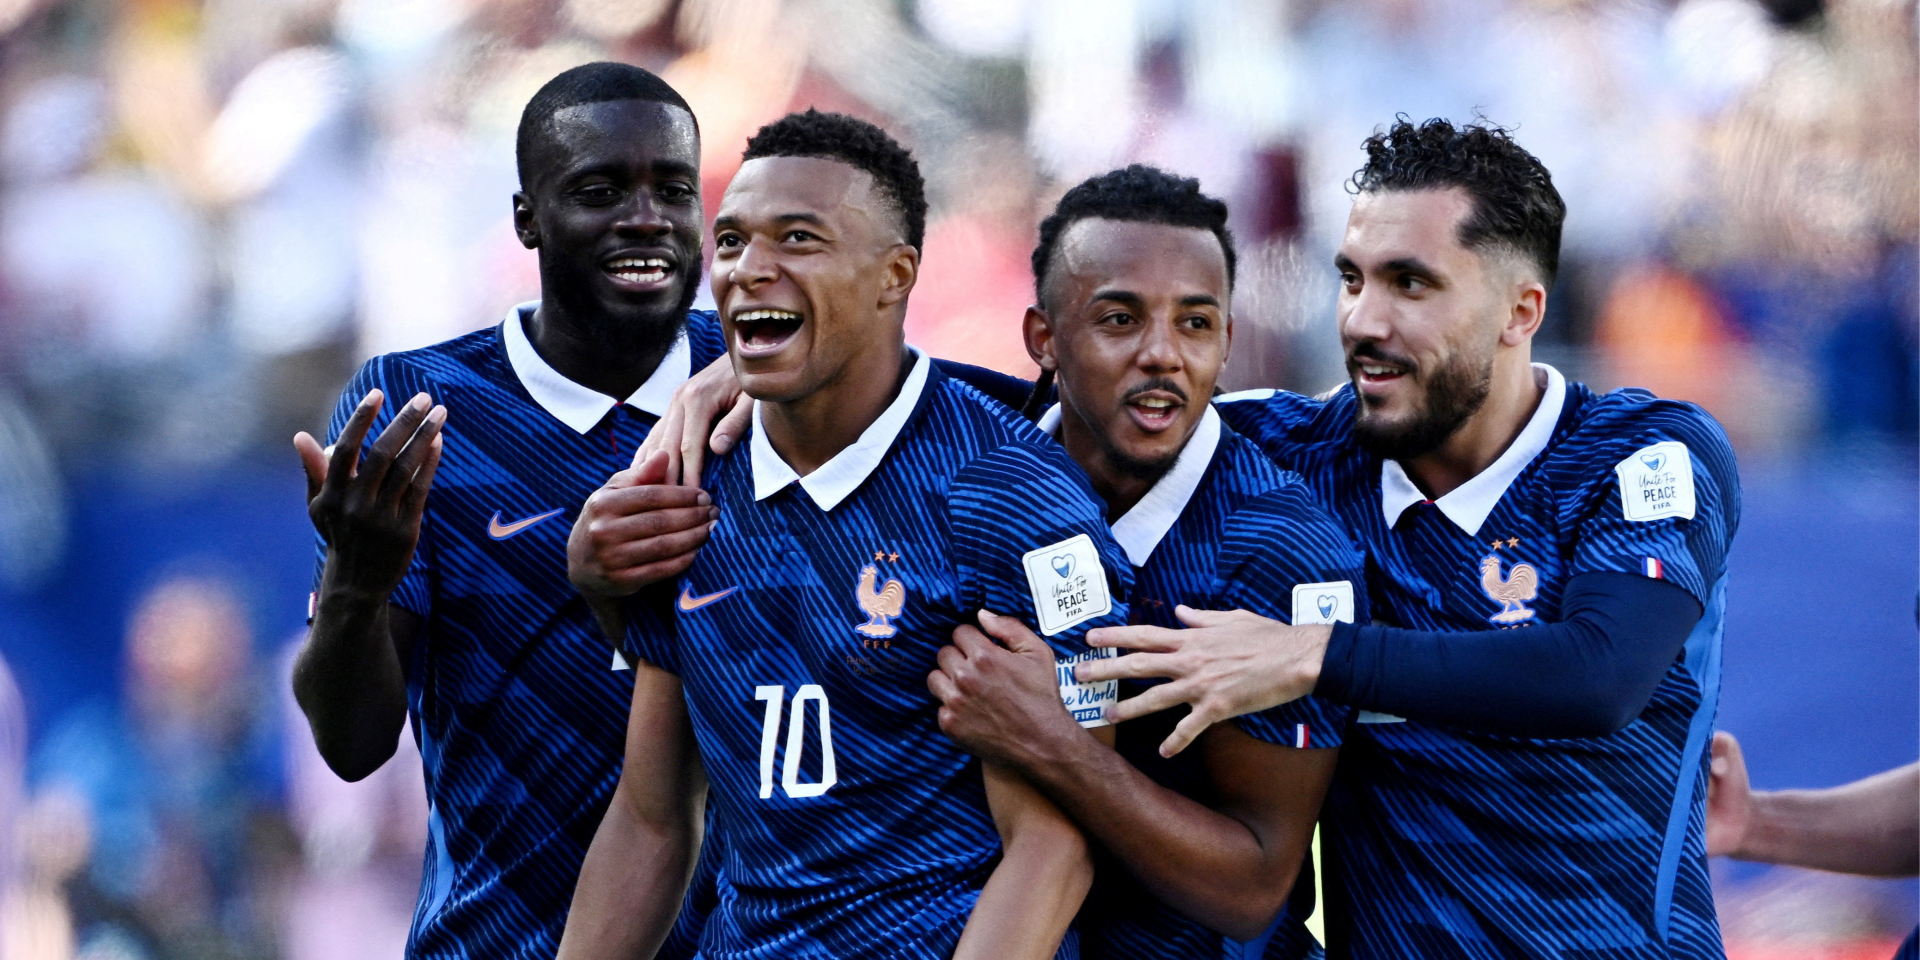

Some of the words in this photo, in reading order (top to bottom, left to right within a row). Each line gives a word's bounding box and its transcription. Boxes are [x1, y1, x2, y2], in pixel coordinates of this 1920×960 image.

[1639, 474, 1663, 488] Unite
[1663, 472, 1676, 485] For
[1643, 486, 1677, 502] PEACE
[1652, 501, 1671, 511] FIFA
[1052, 581, 1074, 598] Unite
[1074, 575, 1087, 588] For
[1057, 589, 1088, 611] PEACE
[1066, 607, 1082, 618] FIFA
[1077, 682, 1116, 705] World
[1074, 709, 1099, 720] FIFA
[755, 684, 837, 799] 10
